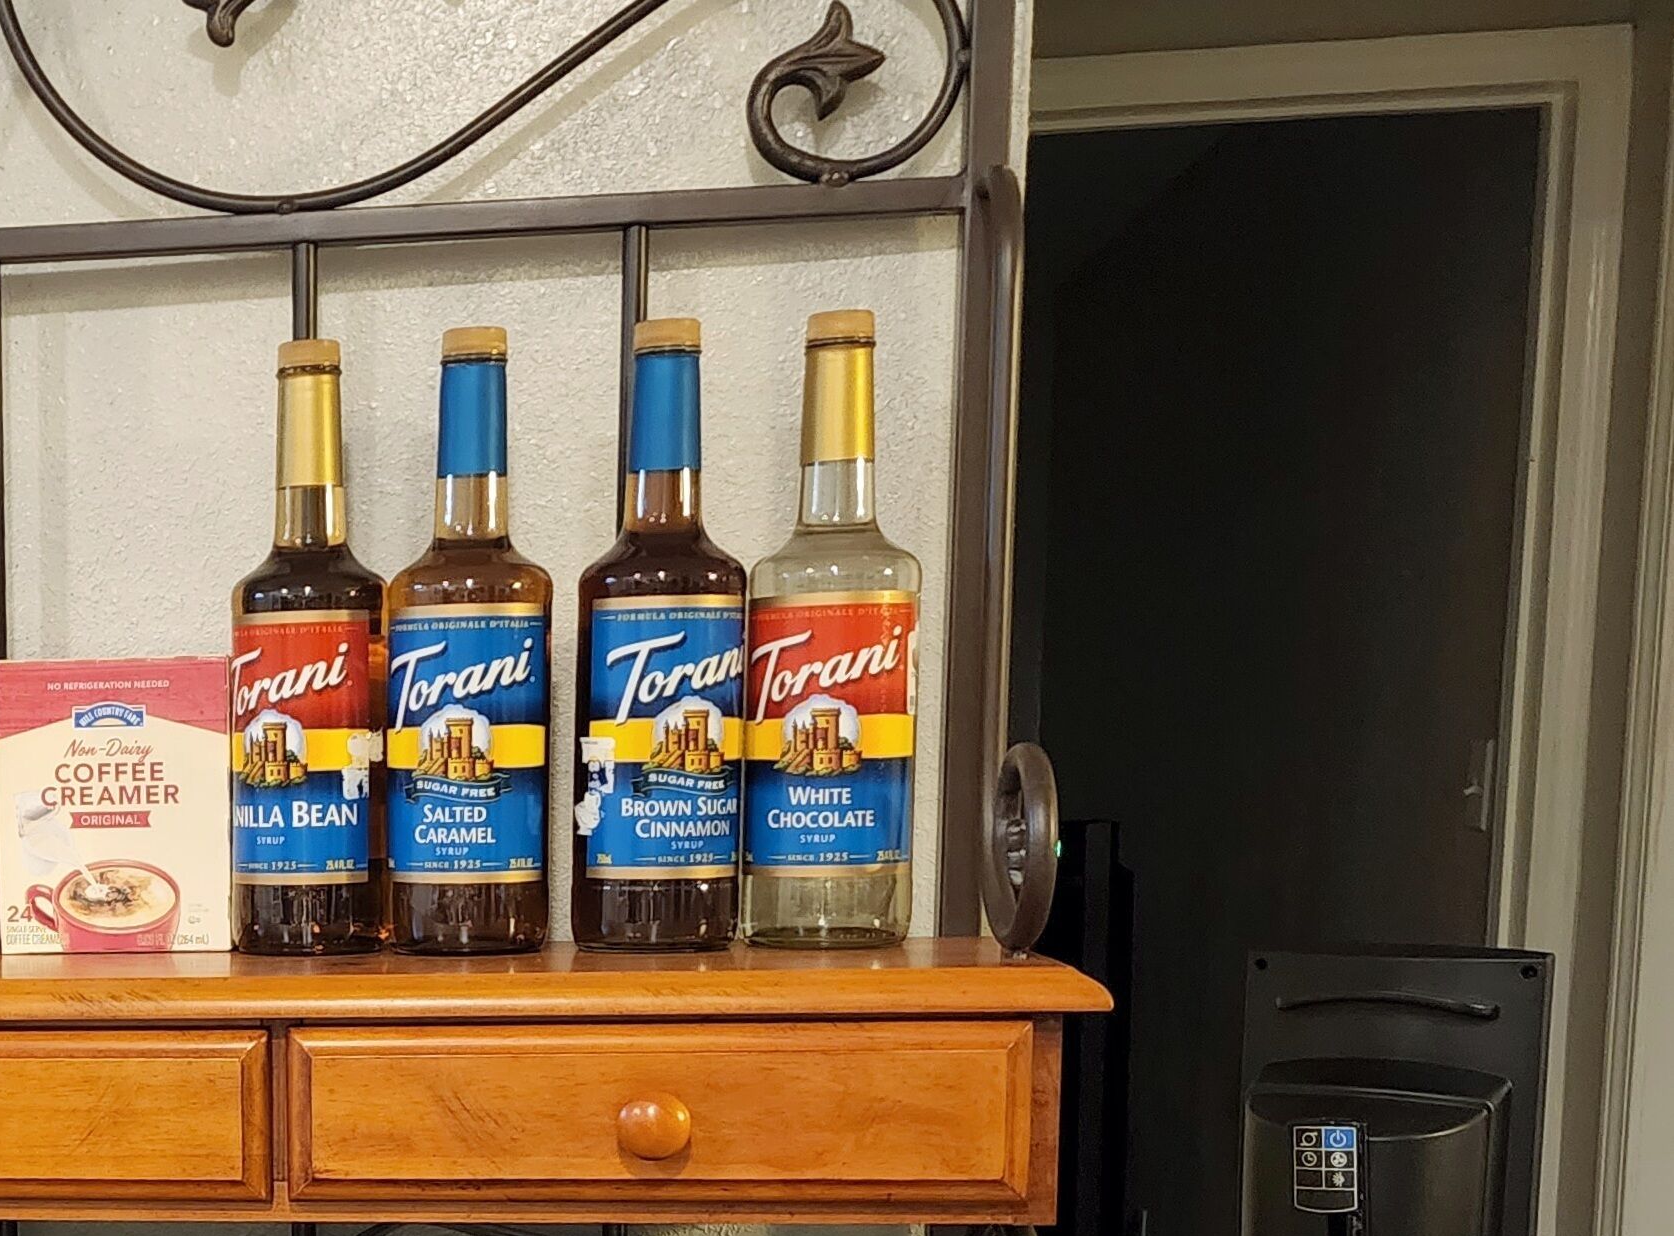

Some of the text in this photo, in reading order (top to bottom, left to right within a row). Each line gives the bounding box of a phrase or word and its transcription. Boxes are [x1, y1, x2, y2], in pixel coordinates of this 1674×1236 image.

[231, 642, 349, 717] Torani
[751, 625, 903, 725] Torani
[47, 680, 170, 691] NO REFRIGERATION NEEDED
[391, 638, 533, 733] Torani
[94, 706, 124, 719] COUNTRY
[64, 737, 153, 763] Non-Dairy
[54, 762, 164, 783] COFFEE
[415, 779, 496, 797] SUGAR FREE
[647, 773, 725, 791] SUGAR FREE
[40, 784, 180, 807] CREAMER
[788, 786, 852, 806] WHITE
[234, 800, 358, 828] NILLA BEAN
[422, 804, 487, 824] SALTED
[621, 798, 692, 818] BROWN
[80, 814, 141, 826] ORIGINAL
[767, 808, 876, 828] CHOCOLATE
[414, 825, 496, 845] CARAMEL
[634, 818, 730, 838] CINNAMON
[256, 836, 286, 846] SYRUP
[670, 840, 705, 850] SYRUP
[799, 833, 836, 844] SYRUP
[435, 846, 469, 856] SYRUP
[689, 852, 714, 863] 1925
[818, 851, 849, 862] 1925
[271, 860, 297, 871] 1925
[453, 859, 481, 869] 1925
[6, 905, 33, 923] 24
[6, 934, 31, 945] COFFEE
